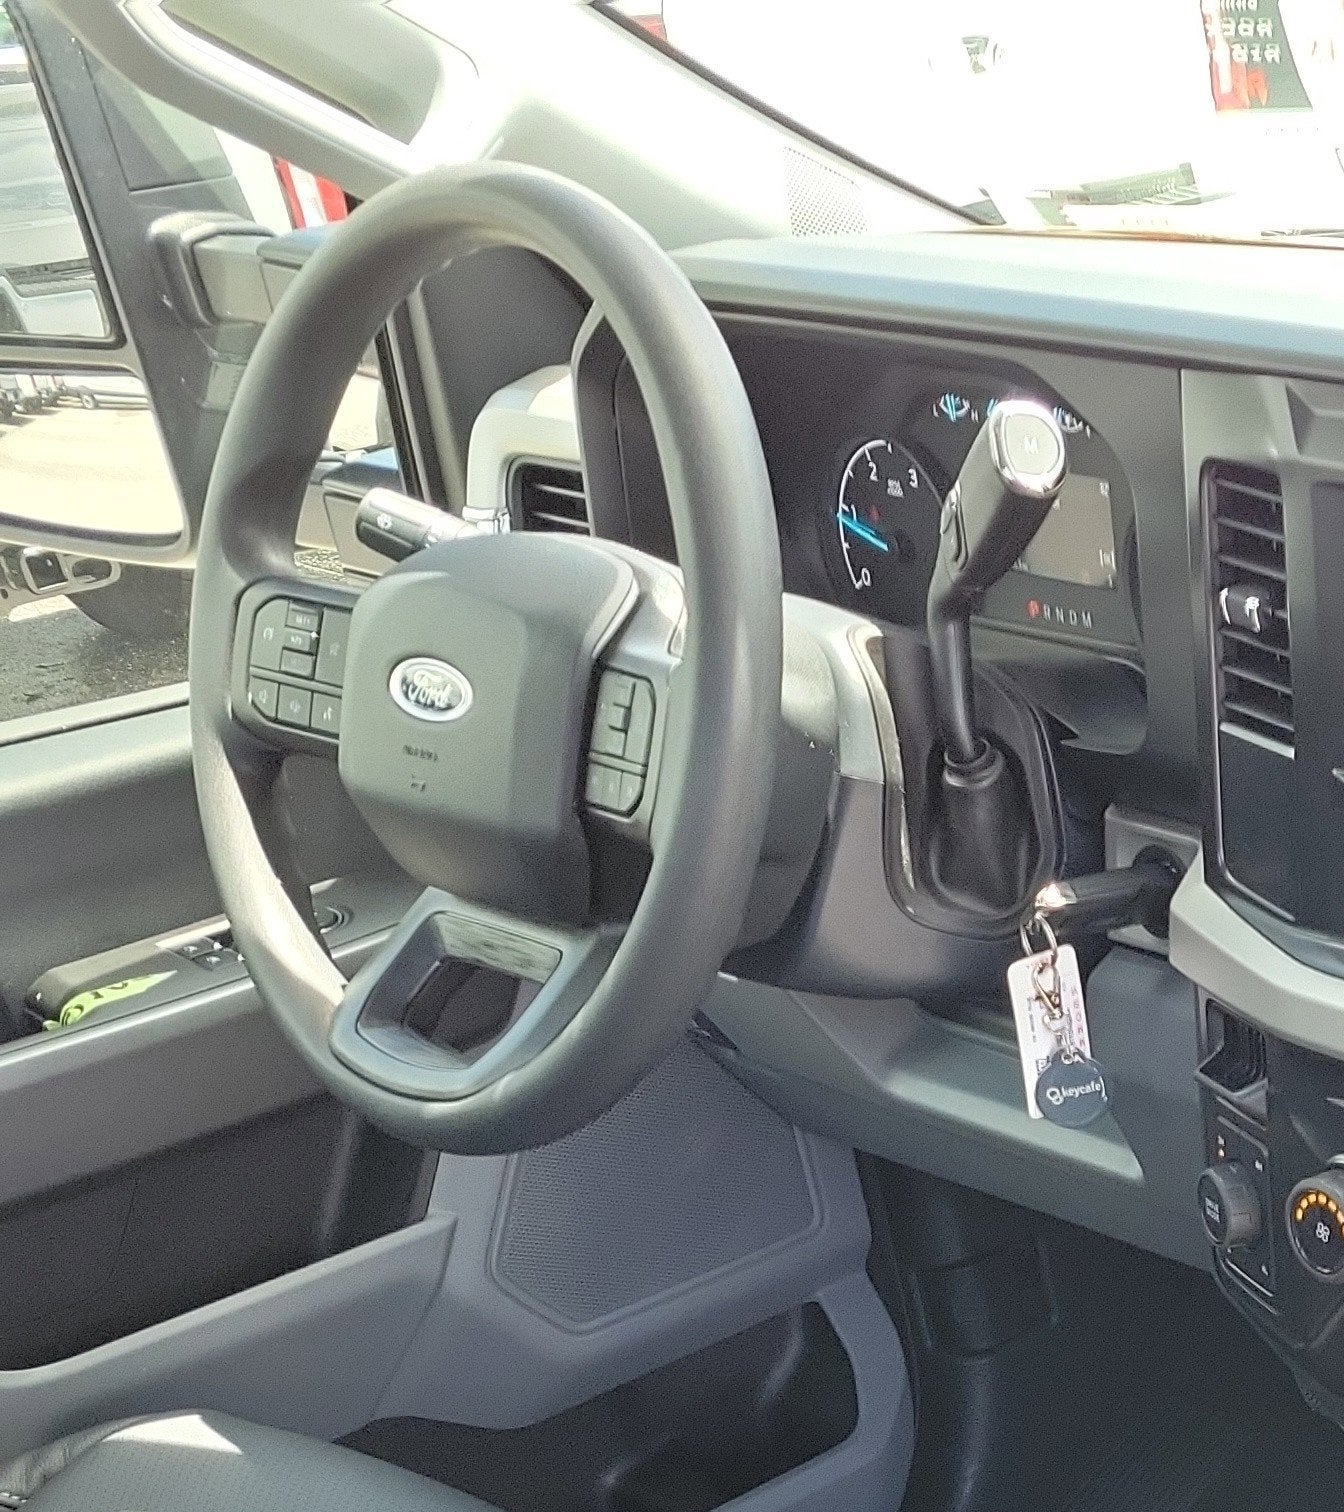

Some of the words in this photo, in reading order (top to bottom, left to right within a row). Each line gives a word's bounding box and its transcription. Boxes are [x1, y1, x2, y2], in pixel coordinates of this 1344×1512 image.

[1023, 436, 1039, 455] M
[868, 462, 878, 481] 2
[908, 468, 918, 488] 3
[861, 568, 871, 587] 0
[409, 669, 453, 709] Ford
[1061, 1079, 1101, 1099] keycafe
